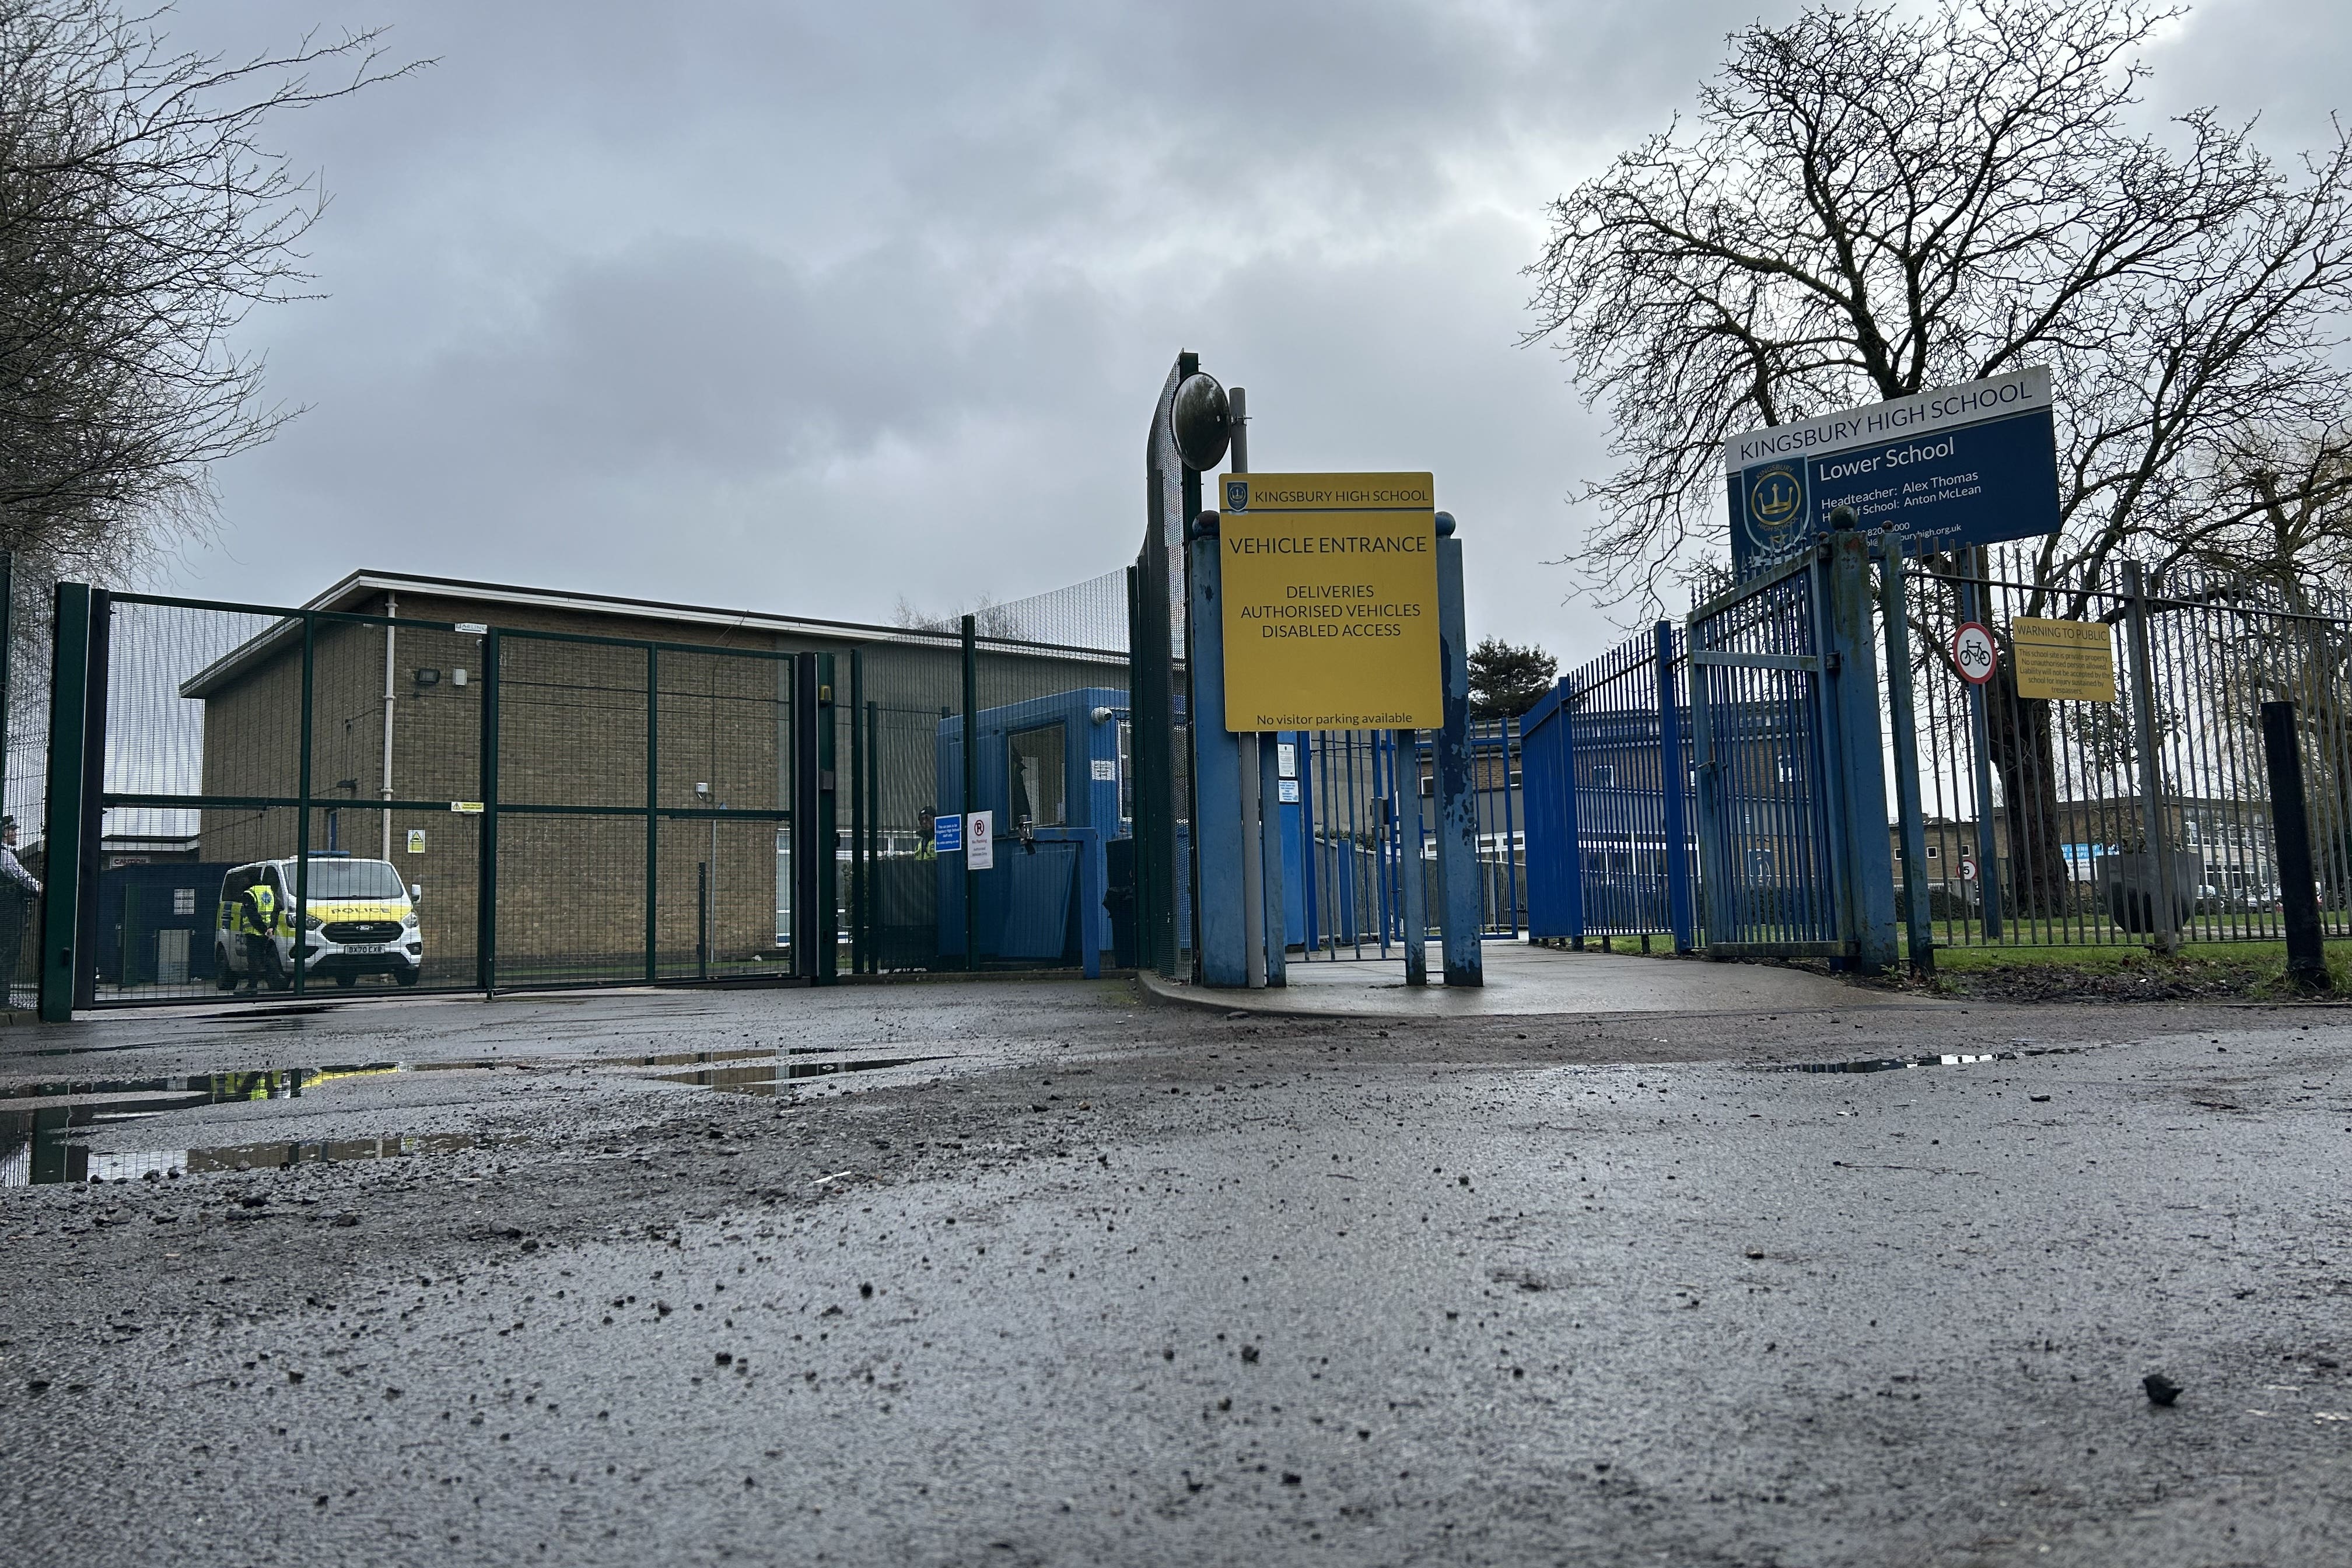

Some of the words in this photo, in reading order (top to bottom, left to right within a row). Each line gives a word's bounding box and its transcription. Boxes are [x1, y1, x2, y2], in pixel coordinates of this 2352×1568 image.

[1740, 418, 1862, 460] KINGSBURY
[1867, 404, 1924, 433] HIGH
[1931, 382, 2033, 419] SCHOOL
[1820, 456, 1881, 481] Lower
[1886, 436, 1955, 468] School
[1755, 464, 1795, 480] KINGSBURY
[1255, 491, 1332, 502] KINGSBURY
[1336, 491, 1370, 502] HIGH
[1373, 490, 1429, 501] SCHOOL
[1822, 488, 1898, 509] Headteacher:
[1902, 481, 1929, 494] Alex
[1930, 471, 1979, 488] Thomas
[1863, 501, 1900, 514] School:
[1903, 494, 1936, 507] Anton
[1938, 485, 1982, 501] McLean
[1757, 522, 1773, 531] HIGH
[1773, 516, 1800, 531] SCHOOL
[1868, 527, 1885, 537] 820
[1229, 537, 1314, 554] VEHICLE
[1319, 536, 1427, 553] ENTRANCE
[1287, 585, 1374, 598] DELIVERIES
[1241, 605, 1342, 618] AUTHORISED
[1346, 604, 1420, 617] VEHICLES
[1262, 625, 1338, 638] DISABLED
[1342, 624, 1401, 636] ACCESS
[2017, 624, 2061, 638] WARNING
[2062, 628, 2074, 639] TO
[2077, 629, 2107, 641] PUBLIC
[2031, 659, 2066, 668] unauthorised
[2020, 667, 2042, 675] Liability
[2056, 678, 2071, 687] injury
[2098, 680, 2104, 688] by
[1257, 715, 1274, 725] No
[1276, 714, 1313, 724] visitor
[1316, 713, 1359, 726] parking
[1362, 712, 1412, 723] available
[1964, 866, 1970, 875] 5
